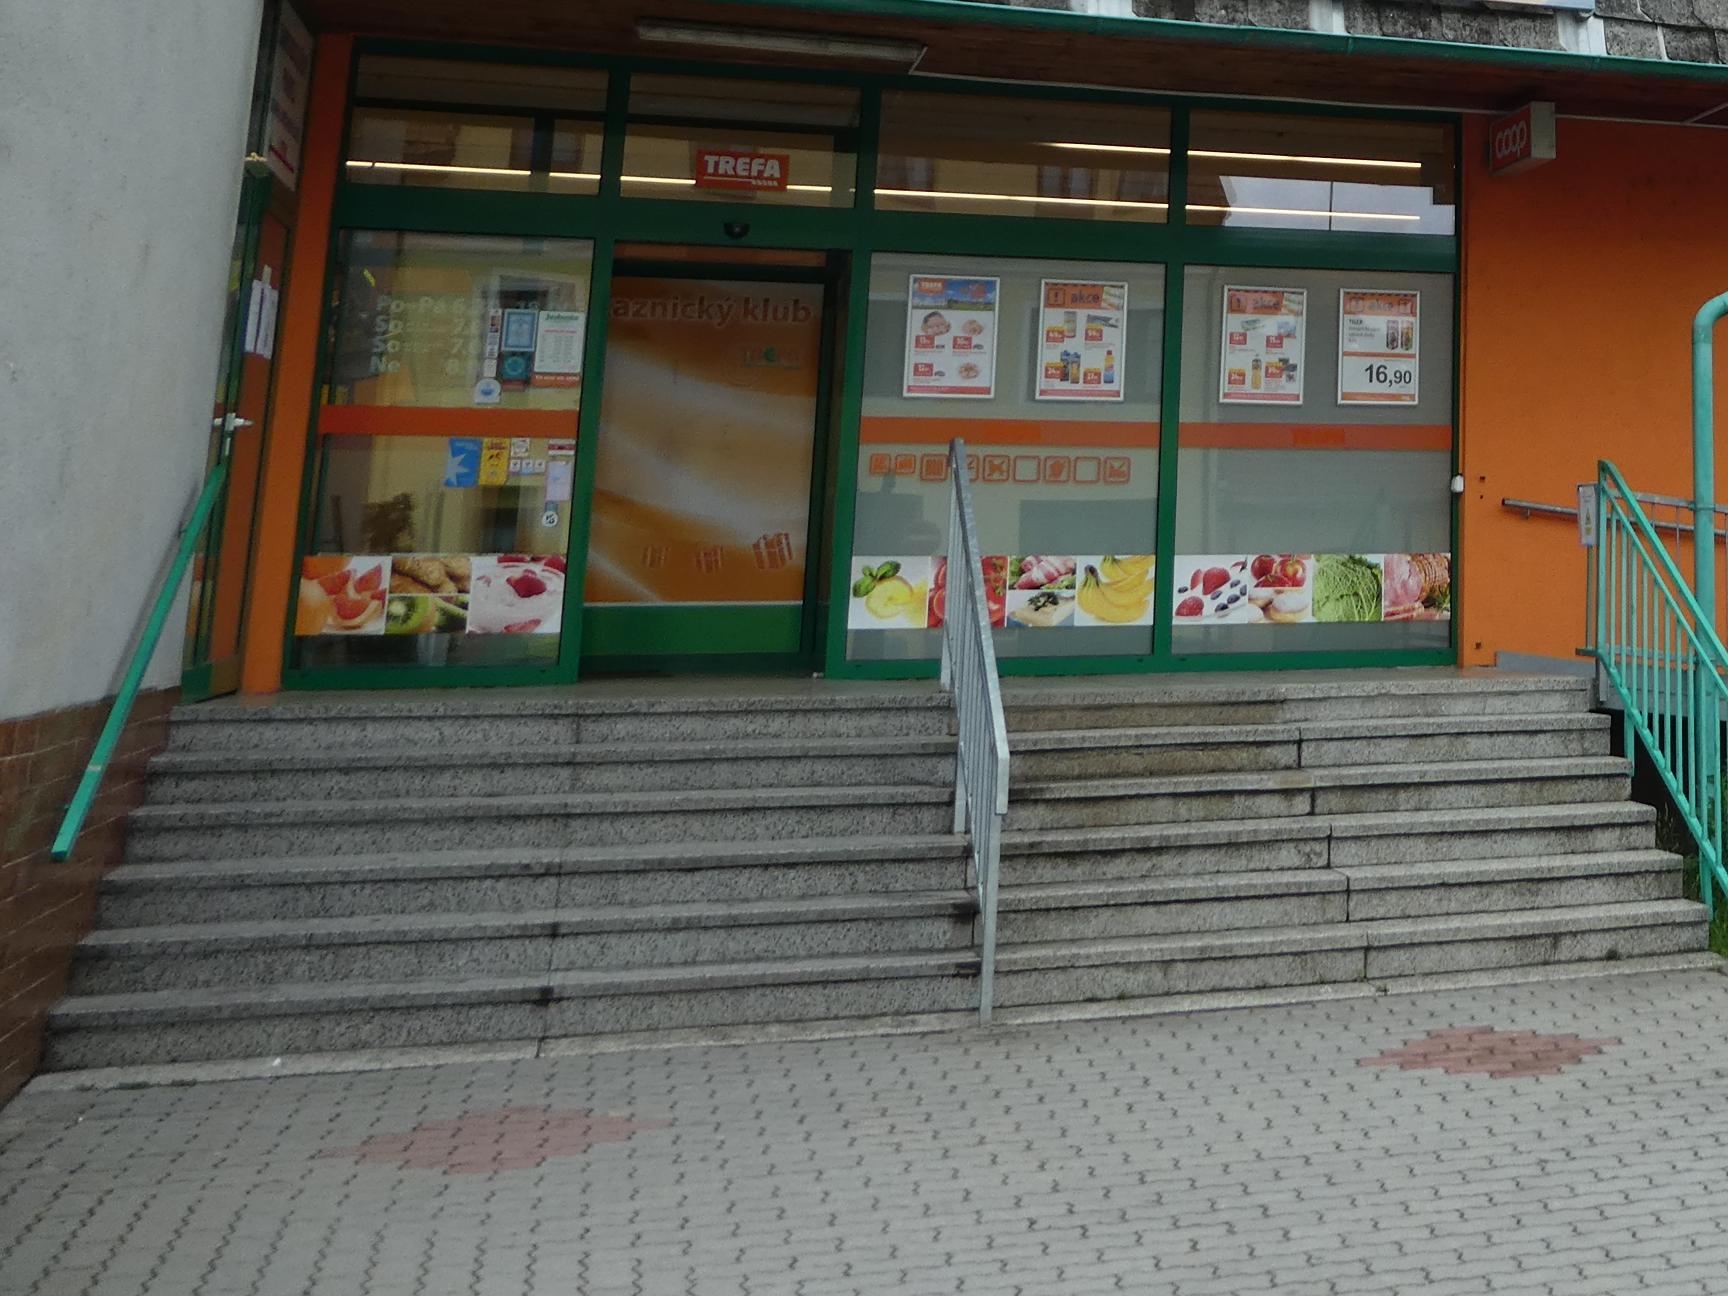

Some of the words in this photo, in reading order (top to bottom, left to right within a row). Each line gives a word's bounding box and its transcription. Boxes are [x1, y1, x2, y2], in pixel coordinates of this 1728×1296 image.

[704, 155, 781, 179] TREFA
[1071, 289, 1100, 304] akce
[611, 296, 733, 328] aznický
[743, 295, 812, 324] klub
[1365, 363, 1412, 388] 16,90
